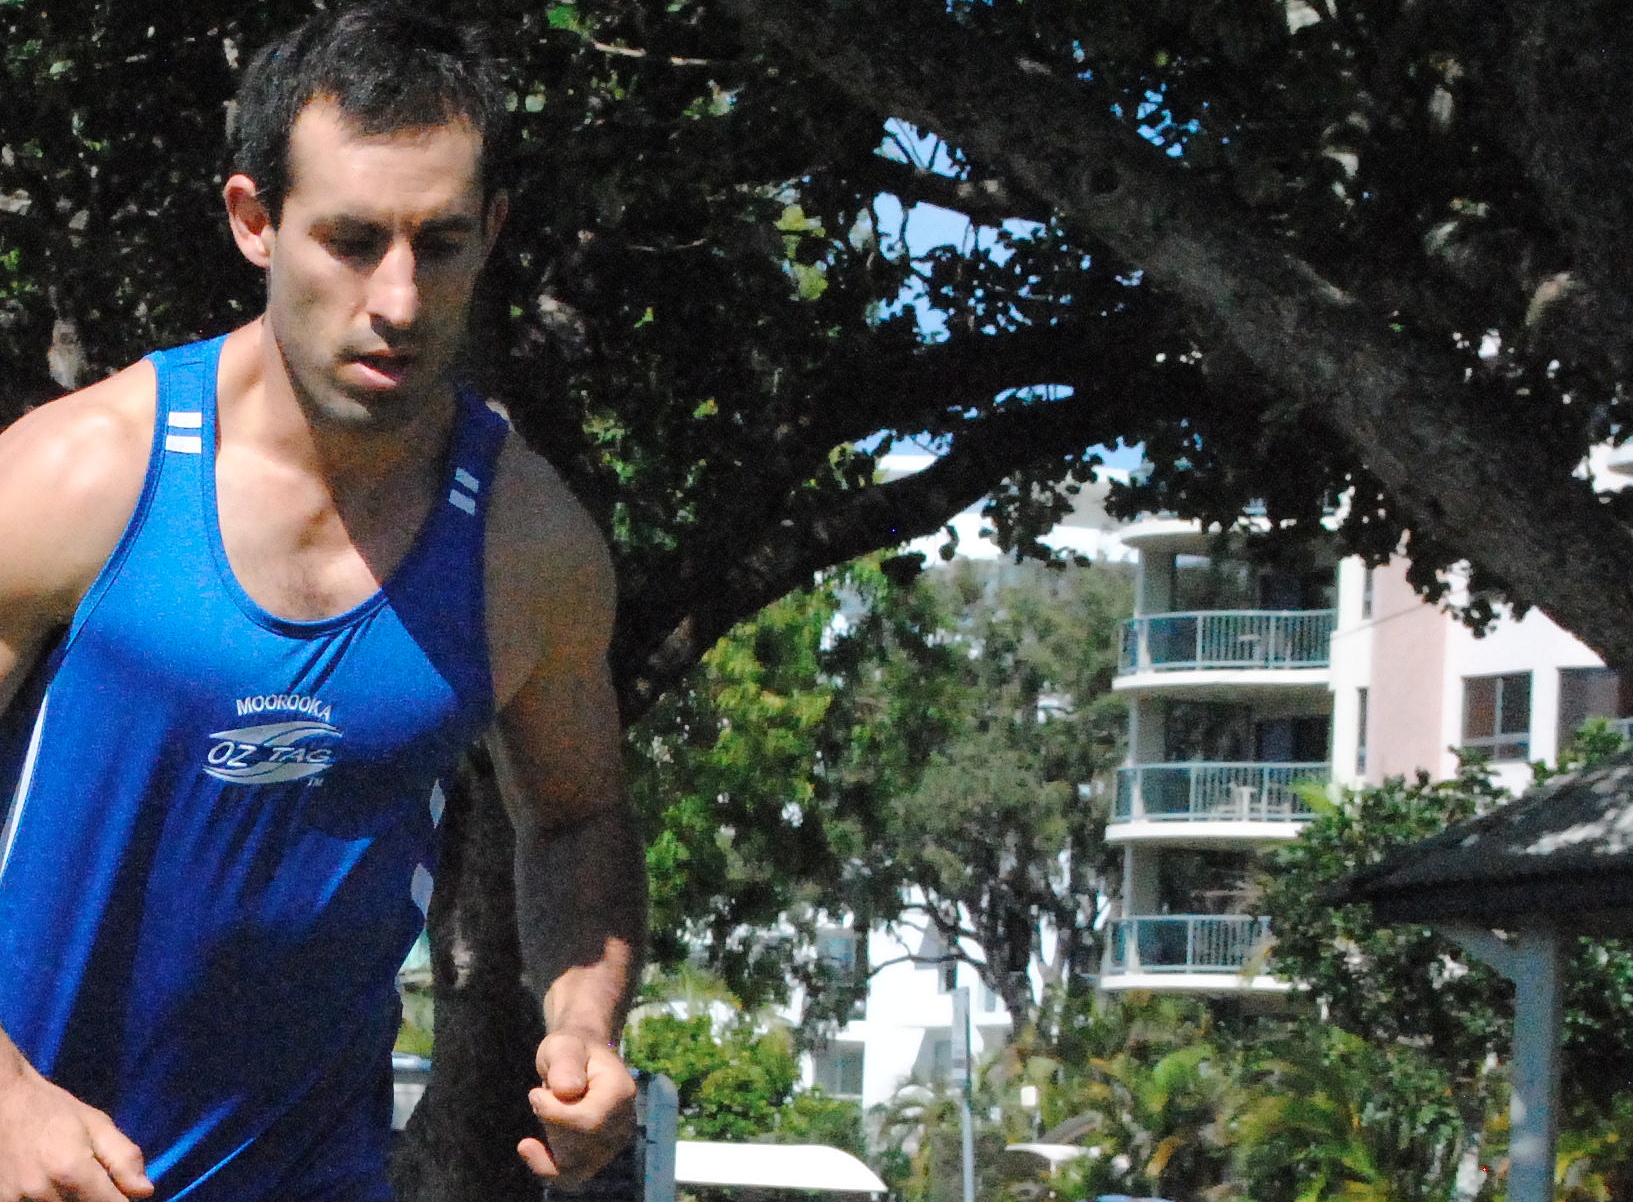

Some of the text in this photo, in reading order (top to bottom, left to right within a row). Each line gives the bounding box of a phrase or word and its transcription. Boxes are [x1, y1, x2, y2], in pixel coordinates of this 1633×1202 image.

[236, 694, 333, 722] MOOROOKA
[207, 741, 333, 768] OZ TAG
